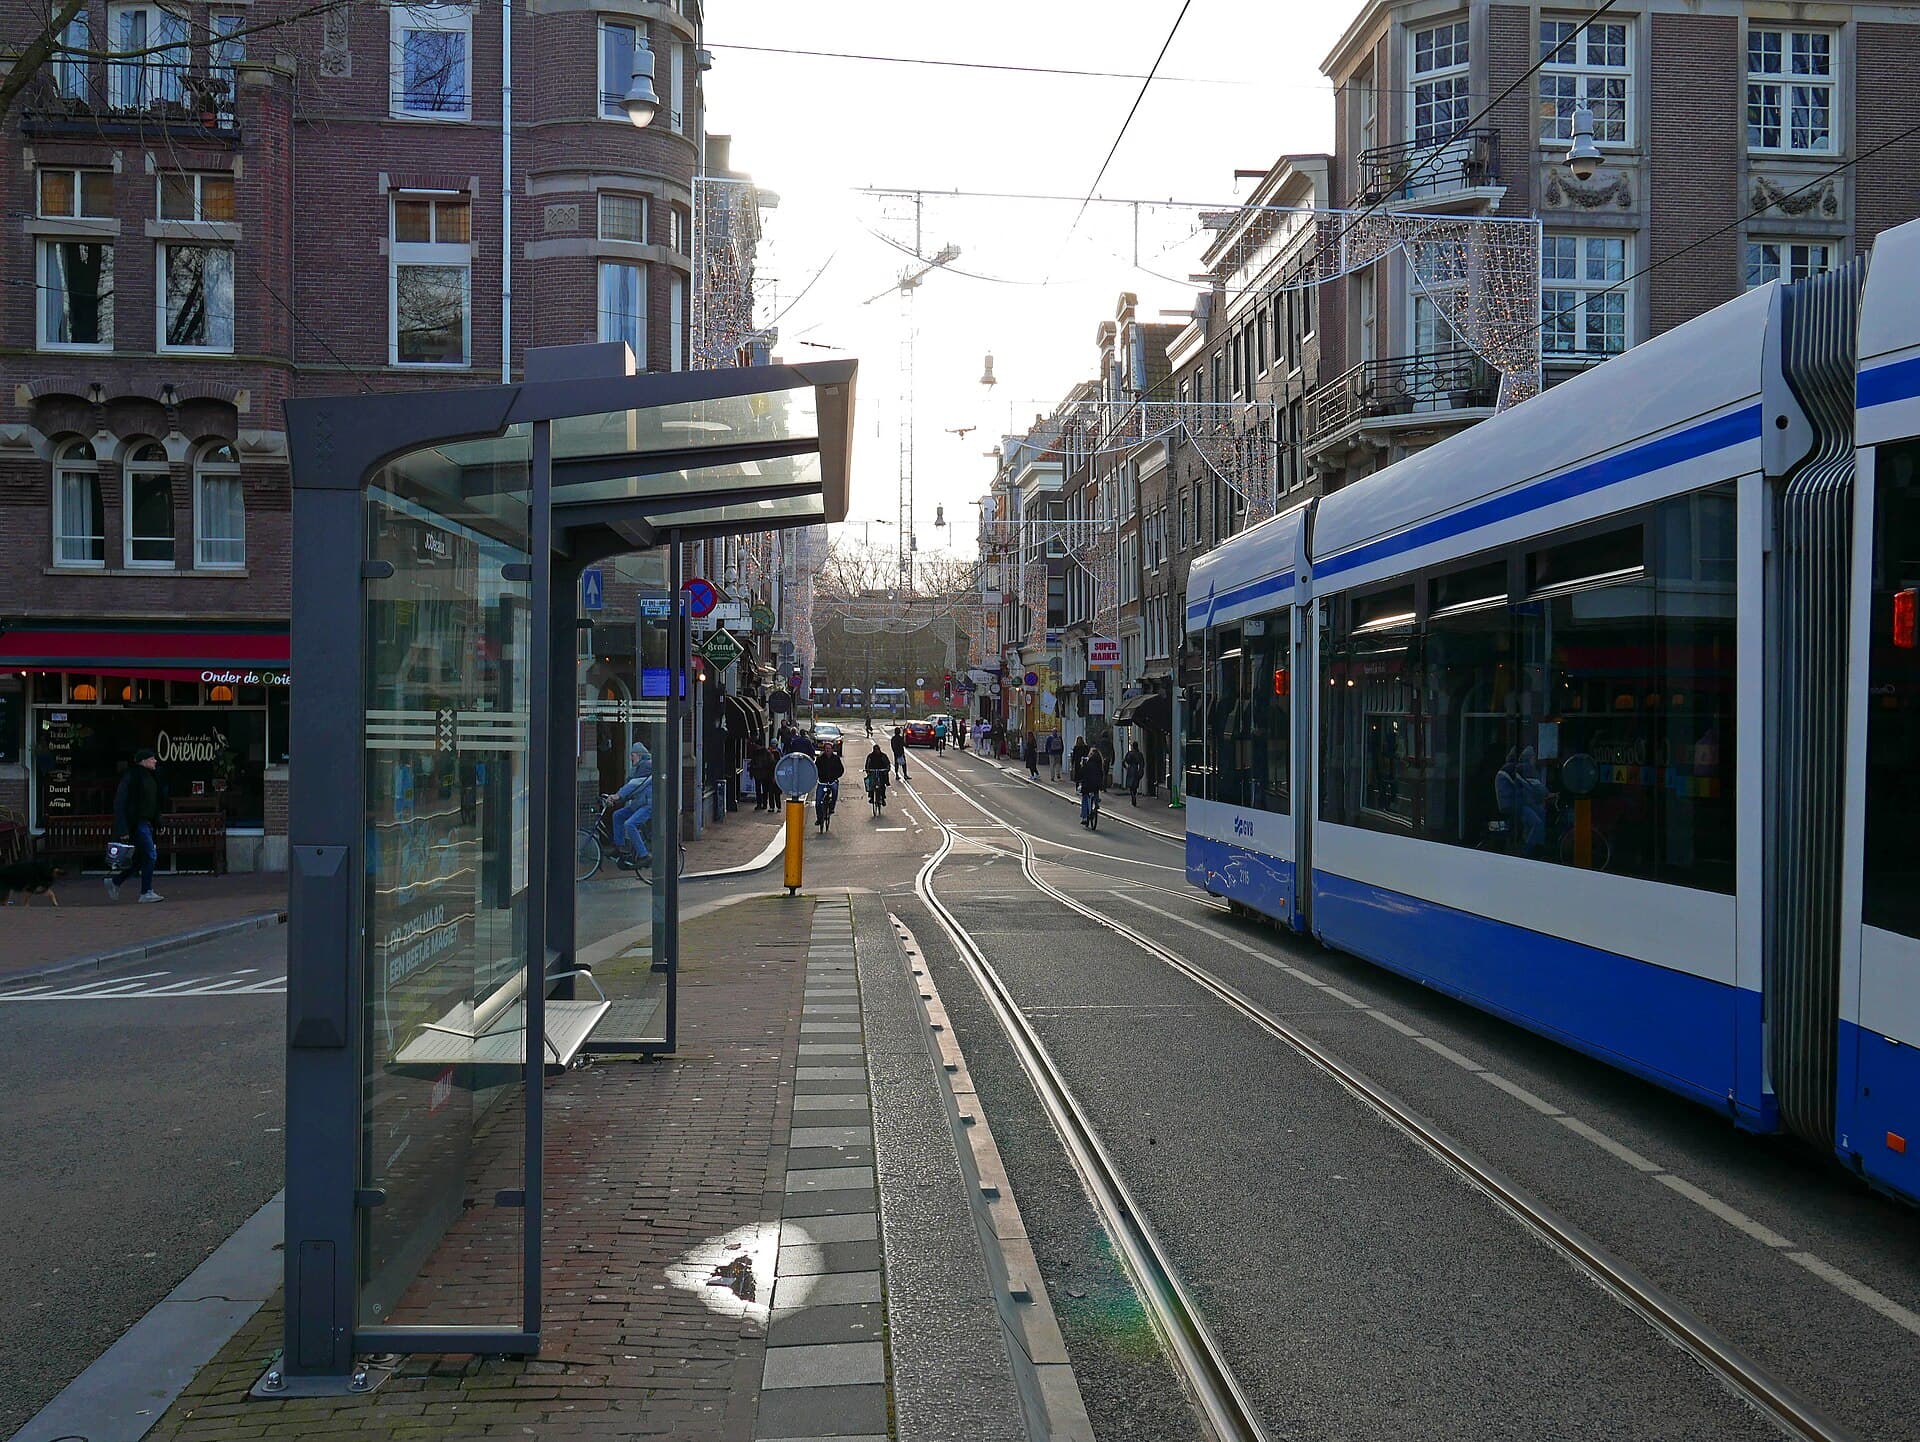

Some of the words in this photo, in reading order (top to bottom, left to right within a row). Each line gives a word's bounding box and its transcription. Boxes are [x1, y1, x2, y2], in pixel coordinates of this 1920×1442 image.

[707, 642, 735, 651] Brand
[1095, 643, 1116, 651] SUPER
[201, 670, 242, 684] Onder
[243, 671, 260, 684] de
[49, 785, 71, 793] Duvel
[1243, 820, 1253, 836] GVB
[390, 928, 402, 952] OP
[403, 914, 423, 945] ZOEK
[423, 904, 444, 930] NAAR
[390, 954, 405, 983] EEN
[405, 937, 430, 972] BEETJE
